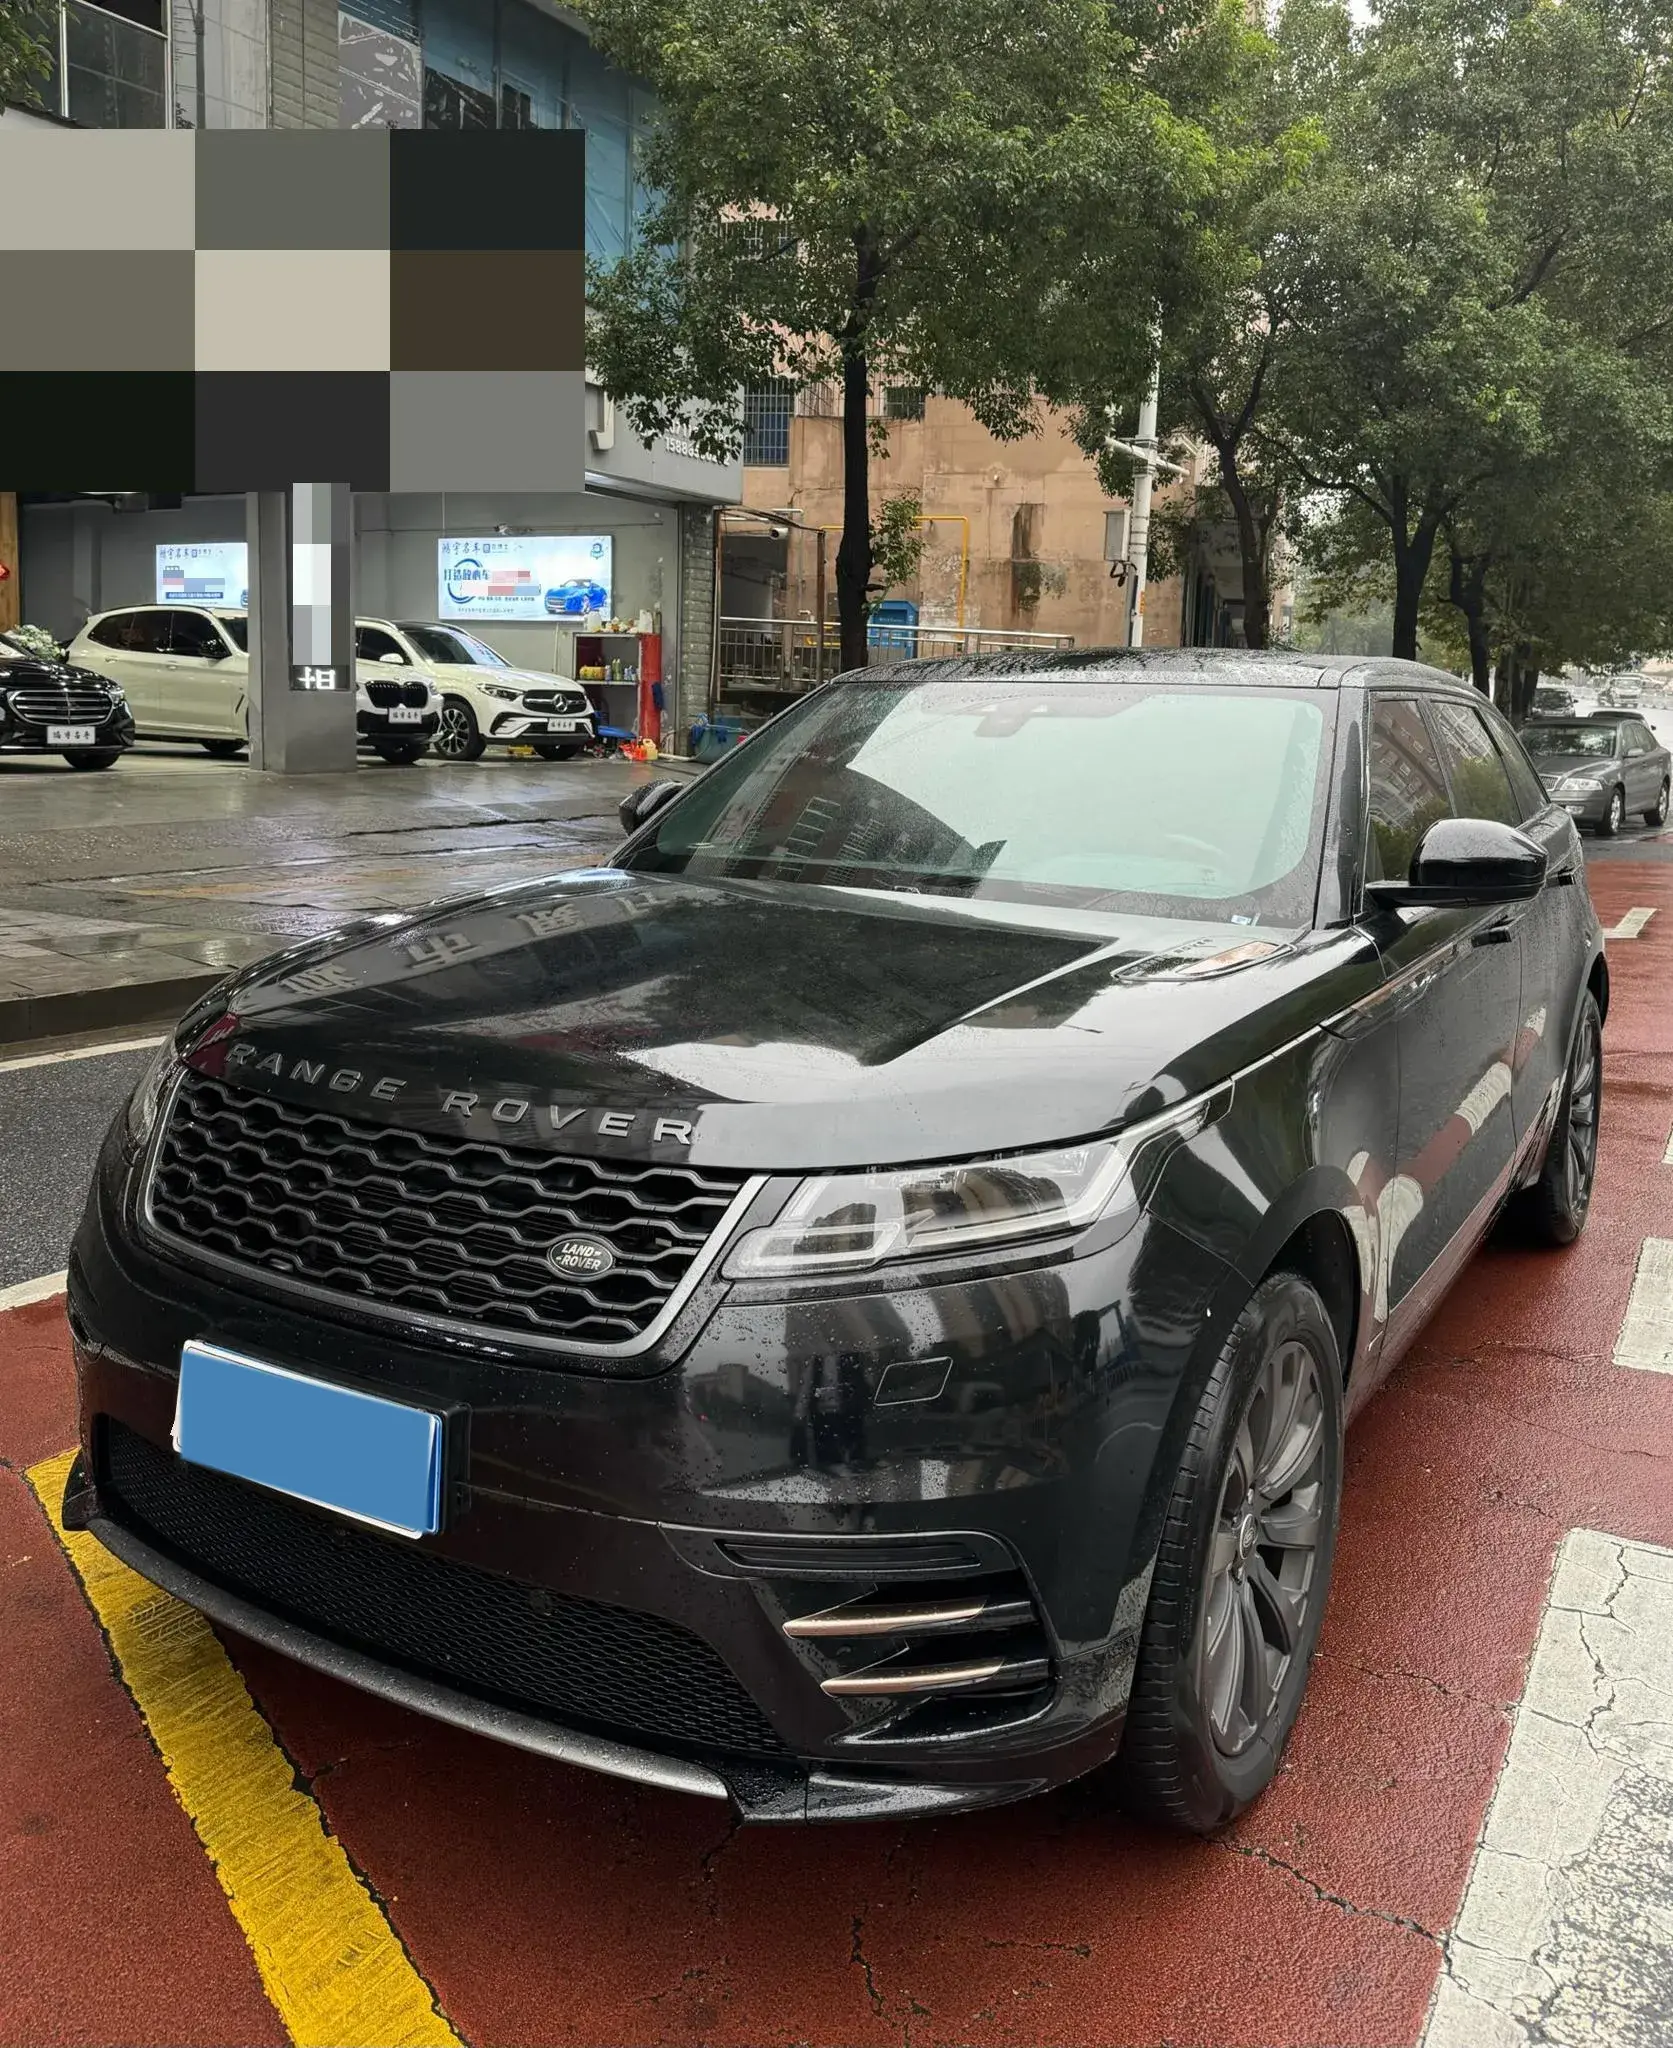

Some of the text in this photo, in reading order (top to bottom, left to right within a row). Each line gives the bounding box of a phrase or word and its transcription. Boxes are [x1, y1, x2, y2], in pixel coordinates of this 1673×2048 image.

[225, 1043, 696, 1145] RANGE ROVER
[562, 1243, 595, 1257] LAND
[561, 1254, 602, 1271] ROVER
